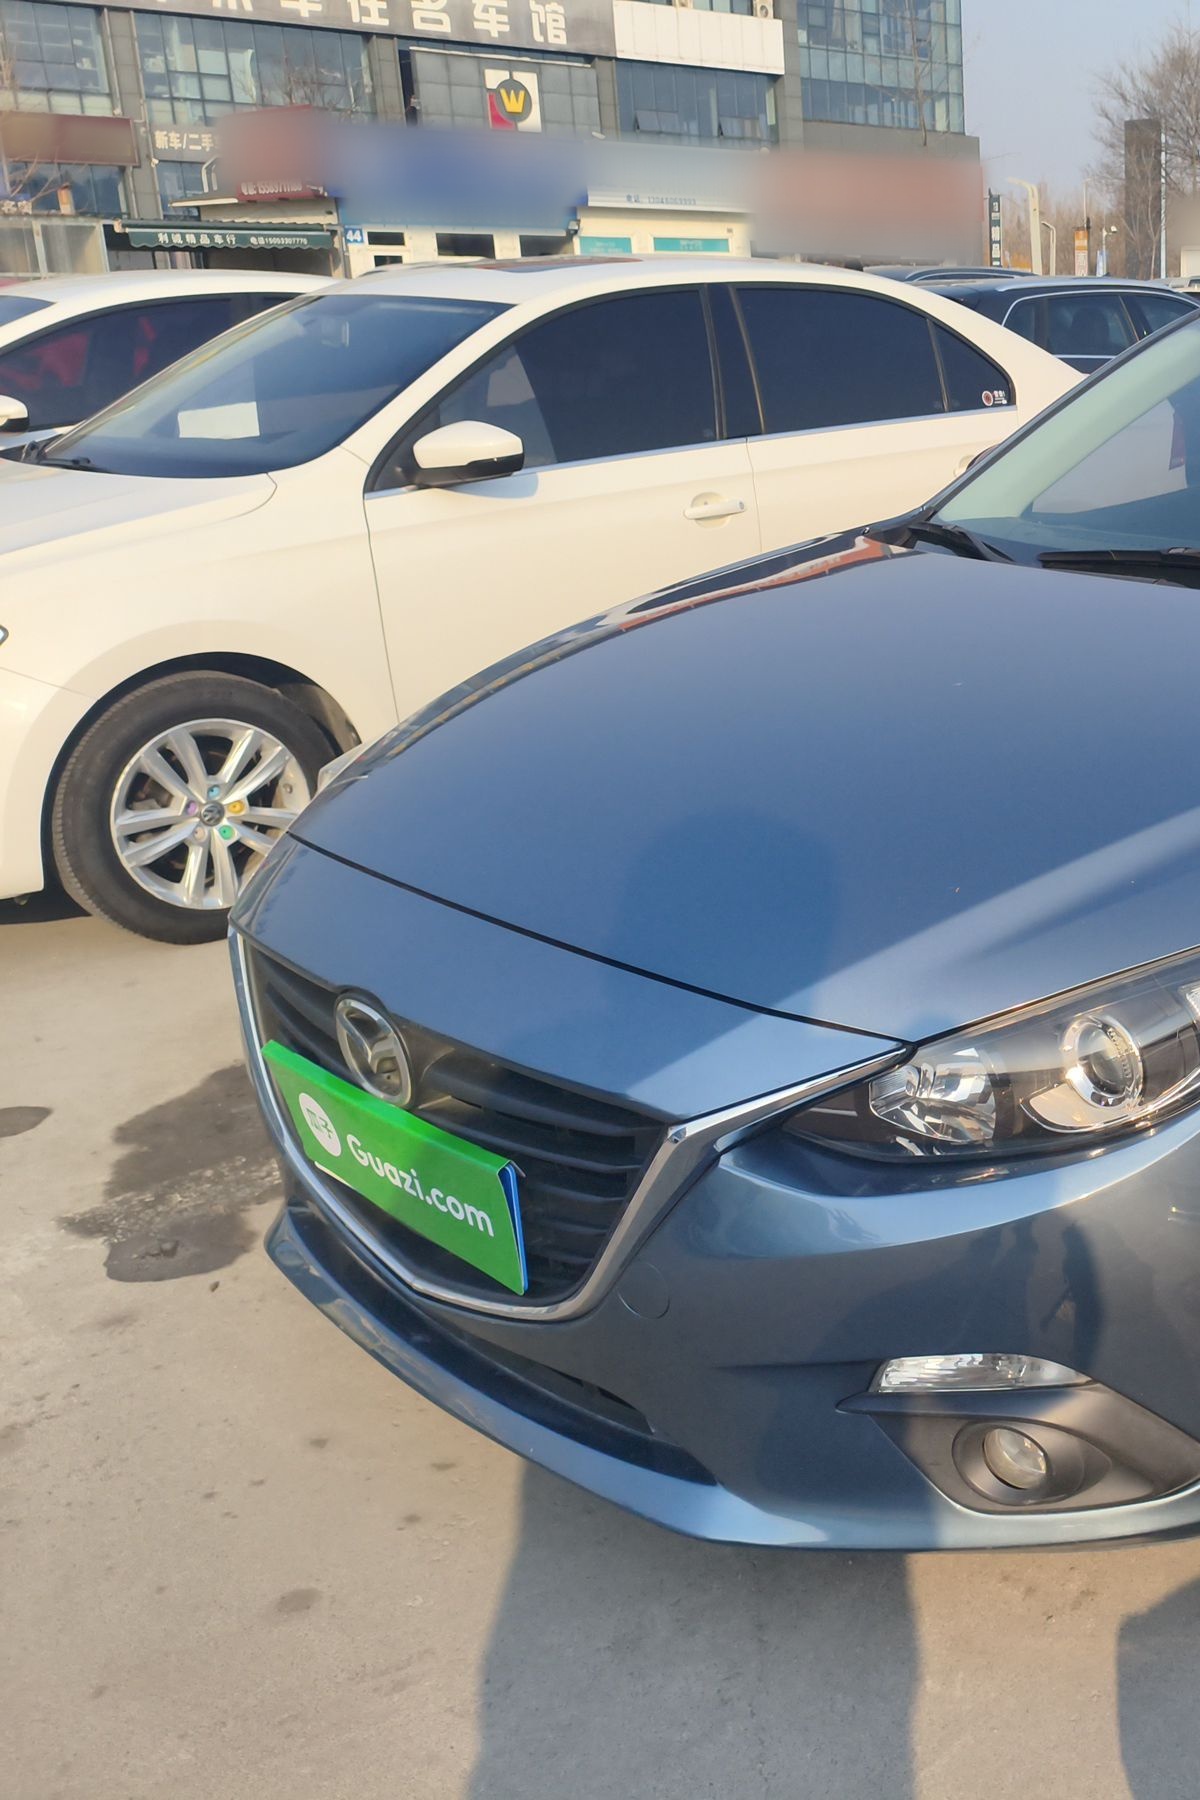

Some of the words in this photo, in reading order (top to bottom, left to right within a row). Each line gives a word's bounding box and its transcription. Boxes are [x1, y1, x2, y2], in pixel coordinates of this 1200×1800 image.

[155, 130, 219, 152] 新车/二手
[346, 230, 362, 242] 44
[346, 1134, 494, 1237] Guazi.com
